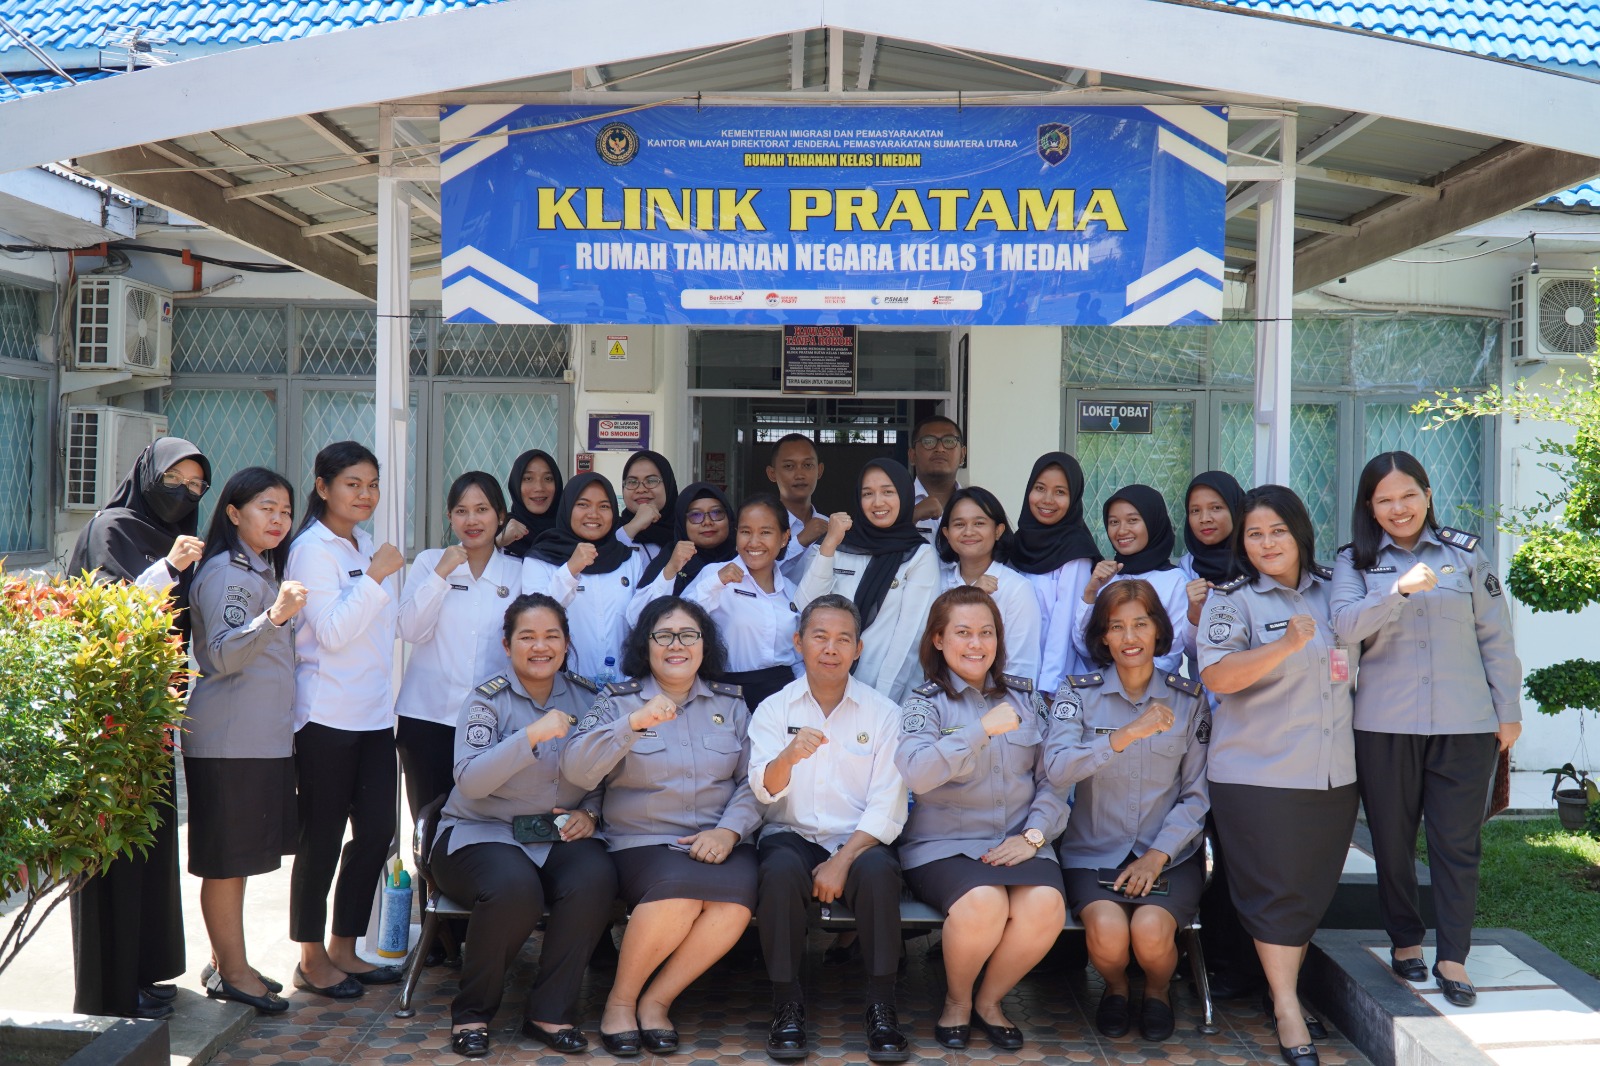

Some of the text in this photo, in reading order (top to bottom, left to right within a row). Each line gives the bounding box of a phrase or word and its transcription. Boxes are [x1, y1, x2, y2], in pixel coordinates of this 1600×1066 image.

[721, 129, 944, 138] KEMENTERIAN IMIGRASI DAN PEMASYARAKATAN
[647, 139, 1018, 148] KANTOR WILAYAH DIREKTORAT JENDERAL PEMASYARAKATAN SUMATERA UTARA
[744, 153, 785, 167] RUMAH
[786, 153, 838, 167] TAHANAN
[839, 153, 874, 167] KELAS
[881, 153, 921, 167] MEDAN
[537, 187, 1129, 232] KLINIK PRATAMA
[576, 242, 1090, 272] RUMAH TAHANAN NEGARA KELAS 1 MEDAN
[794, 326, 844, 337] KAWASAN
[785, 336, 853, 346] TANPA ROKOK
[1082, 405, 1149, 418] LOKET OBAT
